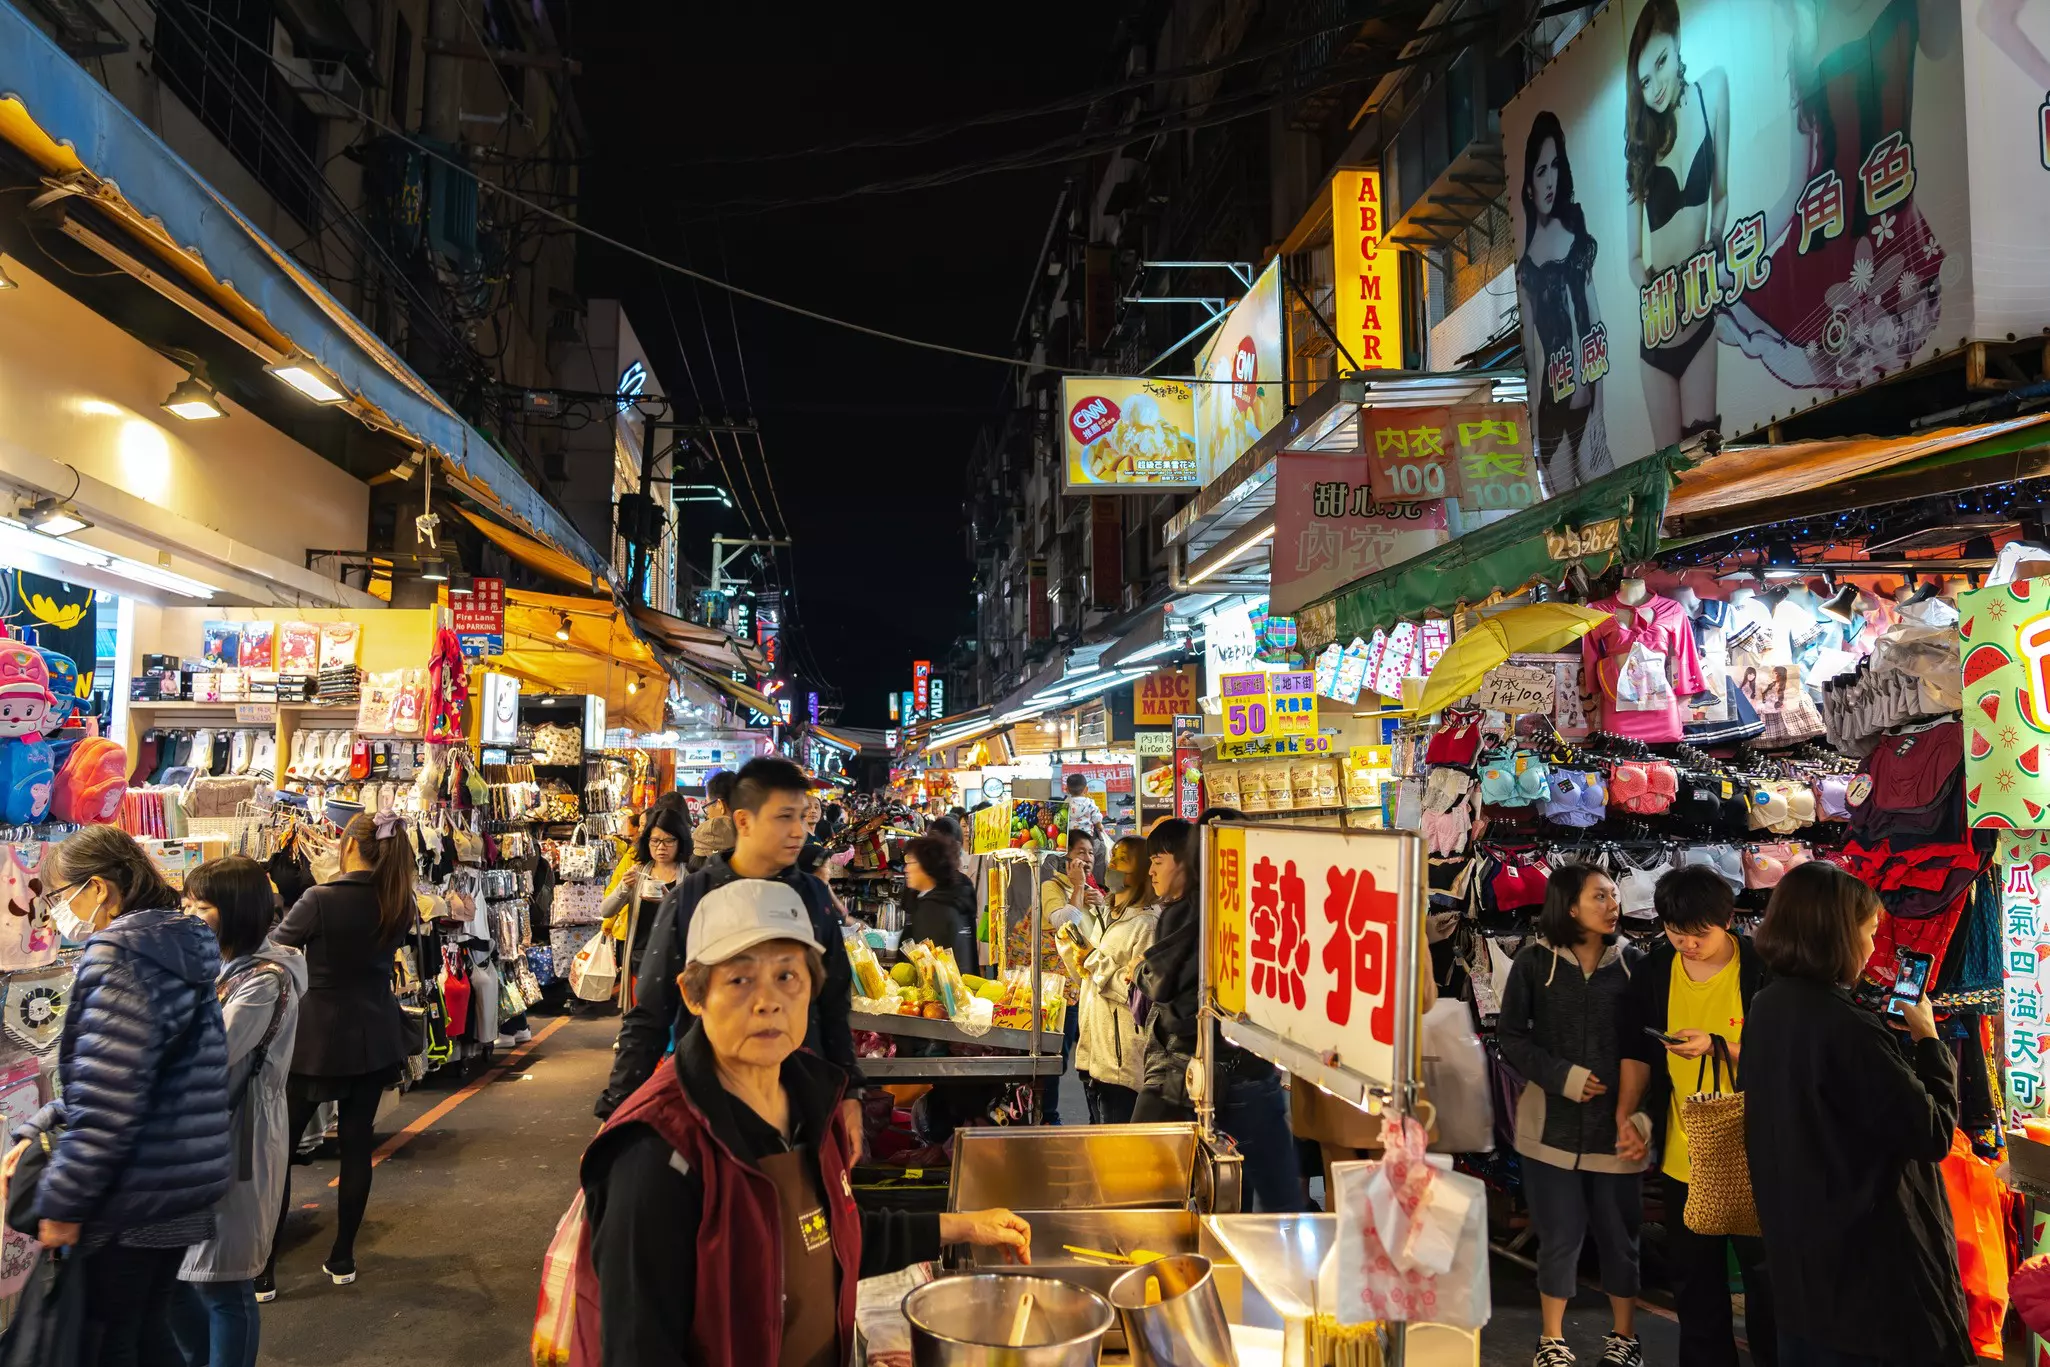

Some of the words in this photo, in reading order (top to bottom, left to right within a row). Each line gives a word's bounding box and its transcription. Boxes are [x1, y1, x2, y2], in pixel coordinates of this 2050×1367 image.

[1797, 130, 1917, 254] 角色
[1640, 210, 1772, 350] 甜心兒
[1548, 320, 1610, 403] 性感
[1073, 398, 1108, 429] CNN
[1384, 462, 1446, 495] 100
[1467, 481, 1533, 508] 100
[466, 623, 496, 631] PARKING
[1142, 675, 1190, 698] ABC
[1282, 675, 1311, 690] 地下街
[1142, 700, 1190, 715] MART
[1229, 703, 1266, 736] 50
[1140, 745, 1164, 753] AirCon
[1304, 737, 1328, 752] 50
[1219, 848, 1240, 991] 現炸
[1250, 856, 1399, 1046] 熱狗
